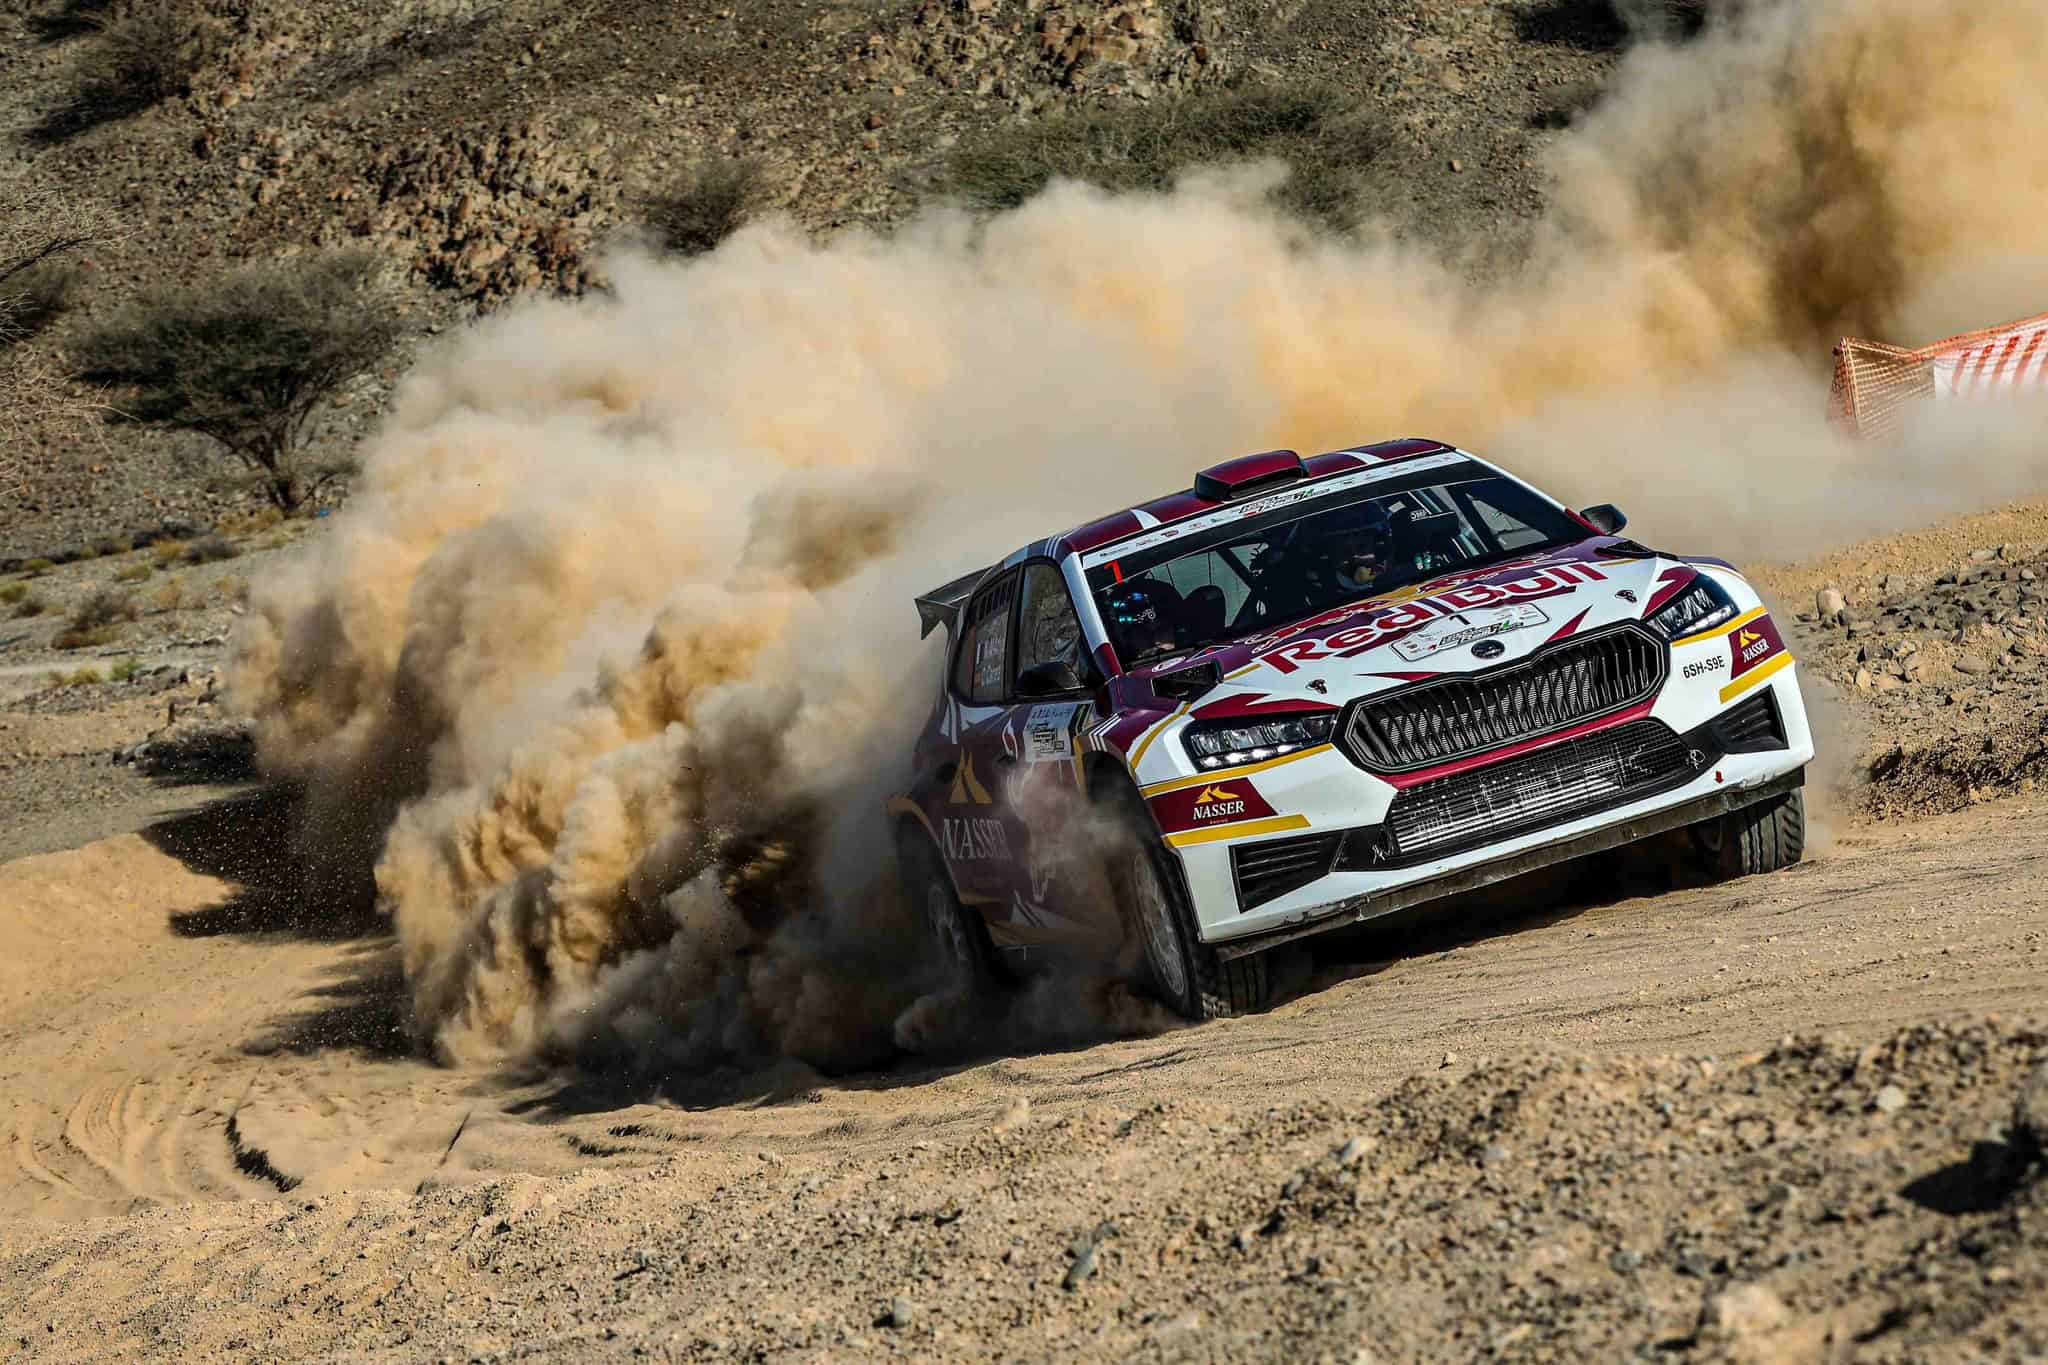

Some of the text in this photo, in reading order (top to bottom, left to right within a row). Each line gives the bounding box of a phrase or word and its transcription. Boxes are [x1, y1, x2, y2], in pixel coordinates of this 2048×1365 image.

[1103, 559, 1123, 585] 1
[1261, 602, 1436, 675] Red
[1436, 563, 1609, 609] Bull
[1450, 614, 1471, 625] 1
[1742, 638, 1770, 663] NASSER
[1193, 800, 1245, 820] NASSER
